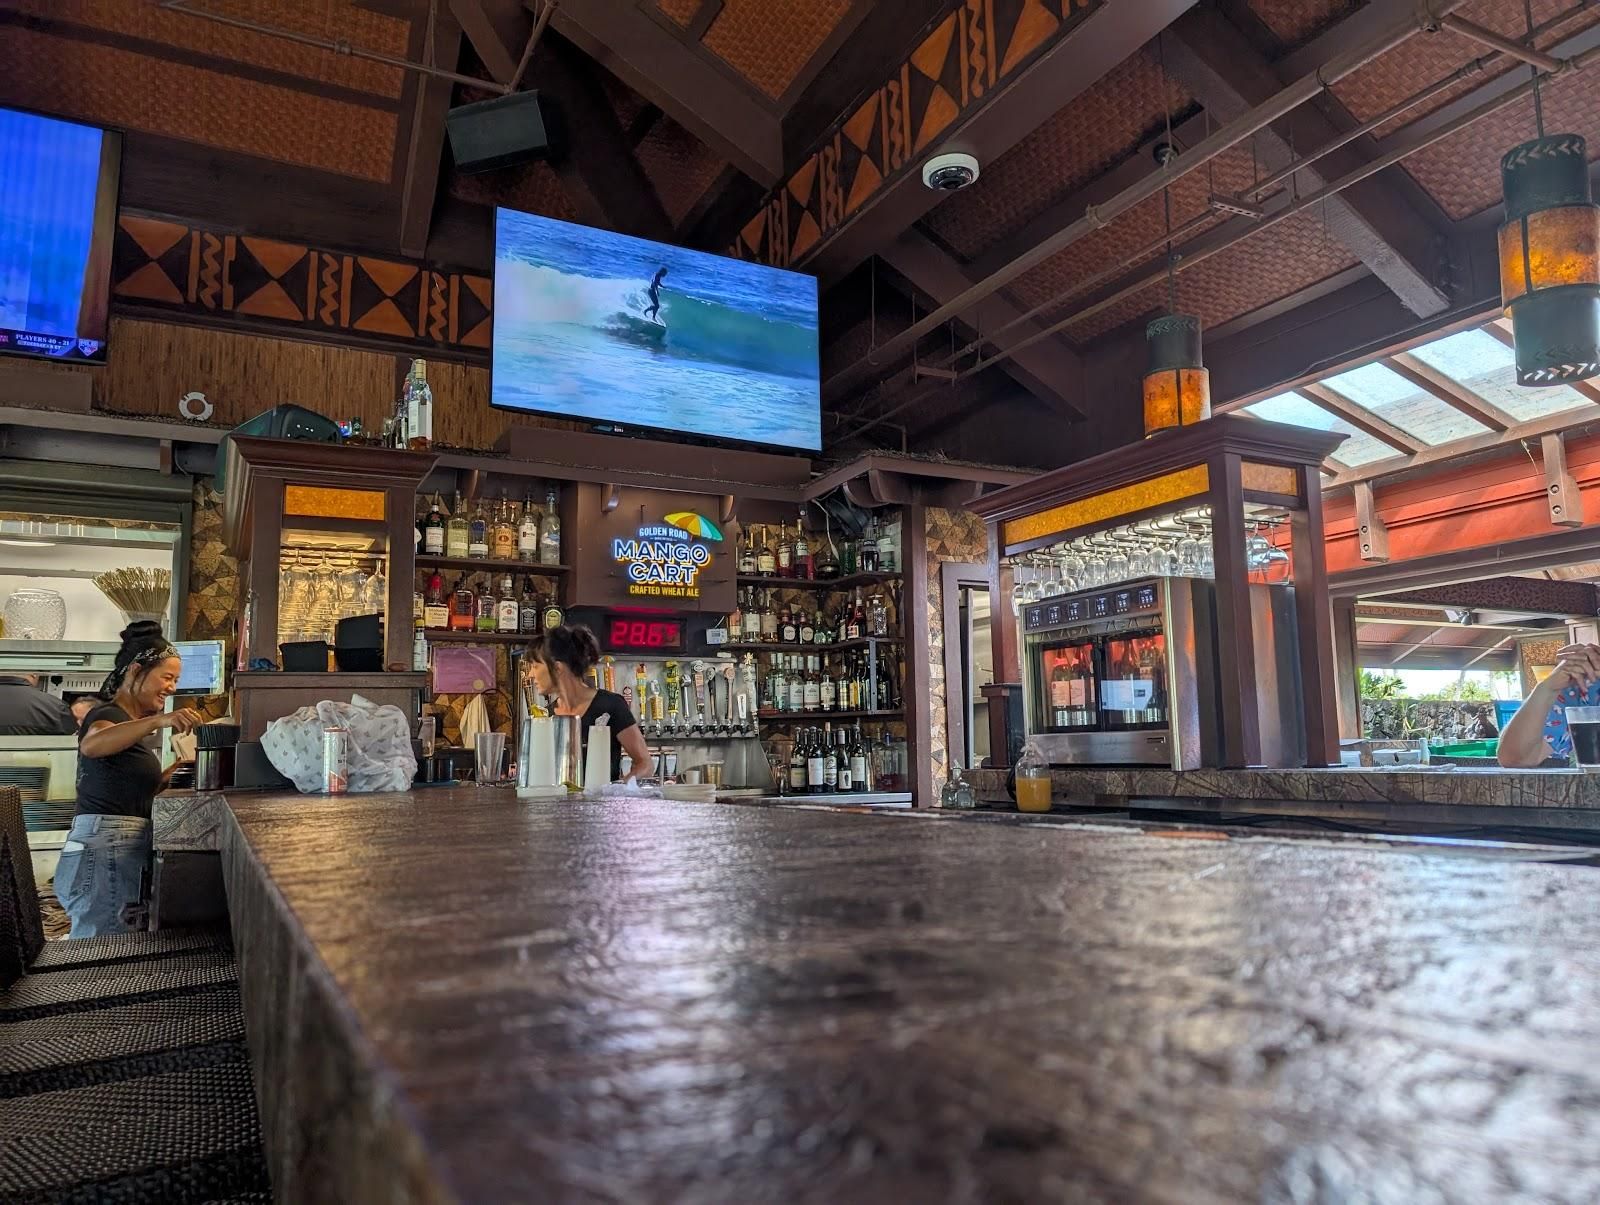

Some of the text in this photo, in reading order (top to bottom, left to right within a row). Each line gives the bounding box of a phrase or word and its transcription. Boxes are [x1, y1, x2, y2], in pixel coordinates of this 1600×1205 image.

[15, 334, 47, 343] PLAYERS
[639, 526, 688, 540] GOLDEN ROAD
[615, 539, 709, 566] MANGO
[628, 563, 697, 584] CART
[629, 585, 700, 597] CRAFTED WHEAT ALE
